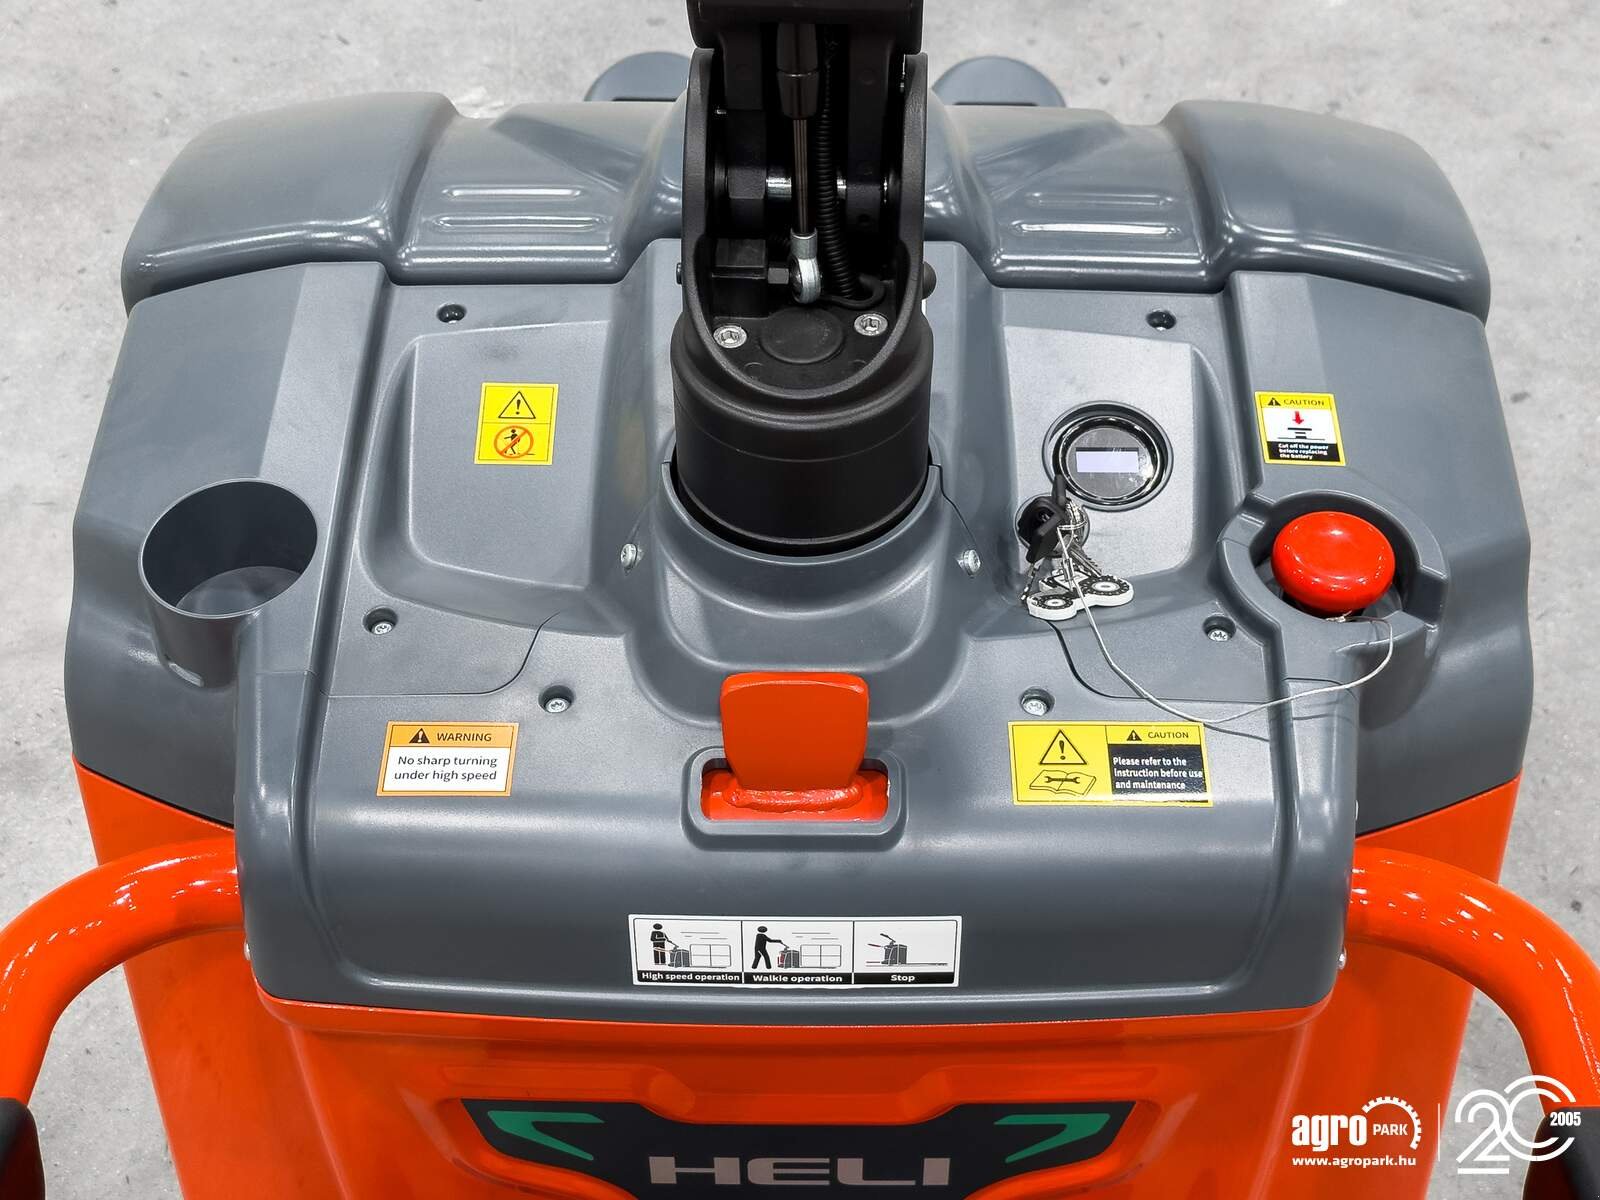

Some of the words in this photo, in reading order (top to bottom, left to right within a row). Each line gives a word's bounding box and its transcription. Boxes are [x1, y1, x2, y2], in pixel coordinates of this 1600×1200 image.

[436, 732, 492, 742] WARNING
[1147, 731, 1189, 739] CAUTION
[398, 756, 415, 766] No
[416, 755, 451, 767] sharp
[453, 756, 498, 768] turning
[1112, 756, 1140, 766] Please
[1141, 757, 1162, 766] refer
[1162, 757, 1172, 766] to
[1173, 756, 1187, 766] the
[394, 770, 430, 780] under
[432, 770, 459, 782] high
[461, 771, 497, 782] speed
[1160, 768, 1188, 778] before
[1188, 770, 1203, 778] use
[1115, 780, 1131, 789] and
[1132, 780, 1186, 789] maintenance
[641, 972, 664, 981] High
[665, 973, 693, 981] speed
[694, 973, 740, 982] operation
[752, 974, 789, 983] Walkie
[790, 974, 843, 983] operation
[890, 974, 916, 983] Stop
[648, 1156, 951, 1186] HELI
